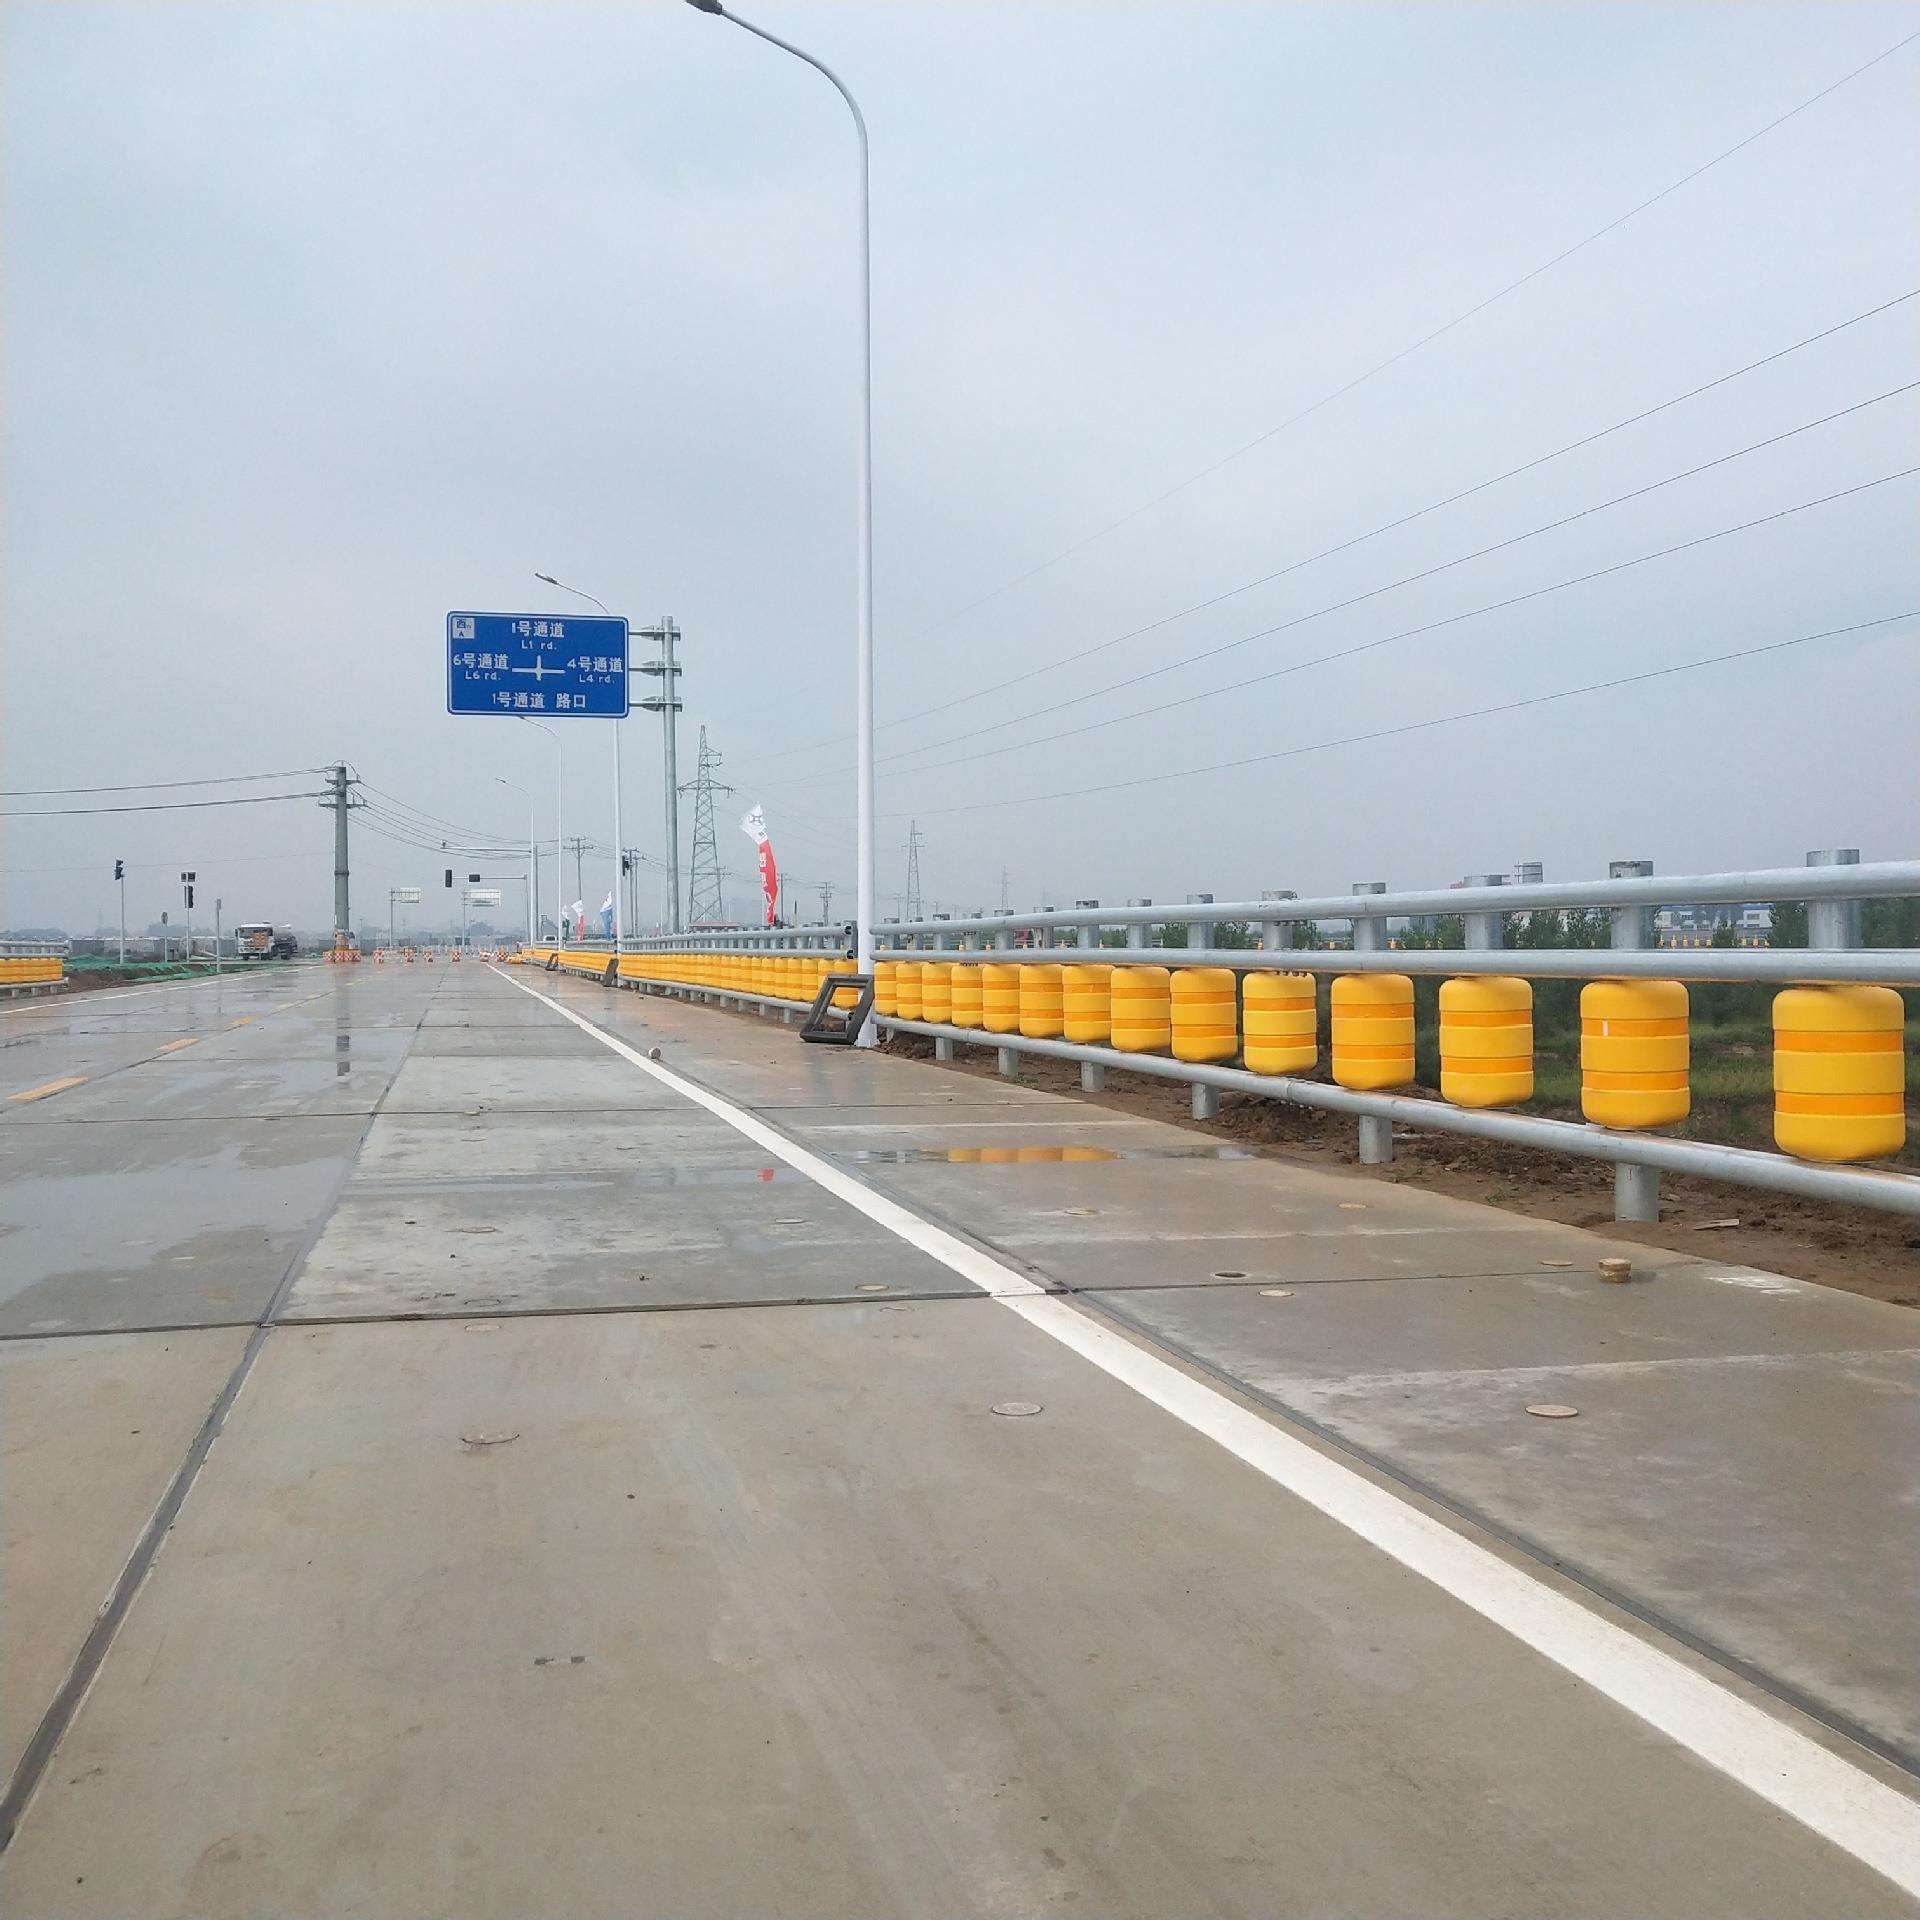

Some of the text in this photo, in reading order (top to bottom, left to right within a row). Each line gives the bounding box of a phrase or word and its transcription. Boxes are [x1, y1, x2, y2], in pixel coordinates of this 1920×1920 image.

[511, 620, 565, 638] 1号通道
[521, 639, 557, 650] L1 rd.
[453, 653, 509, 670] 6号通道
[567, 656, 623, 673] 4号通道
[465, 671, 501, 681] L6 rd.
[579, 674, 616, 684] L4 rd.
[492, 691, 587, 709] 1号通道 路口
